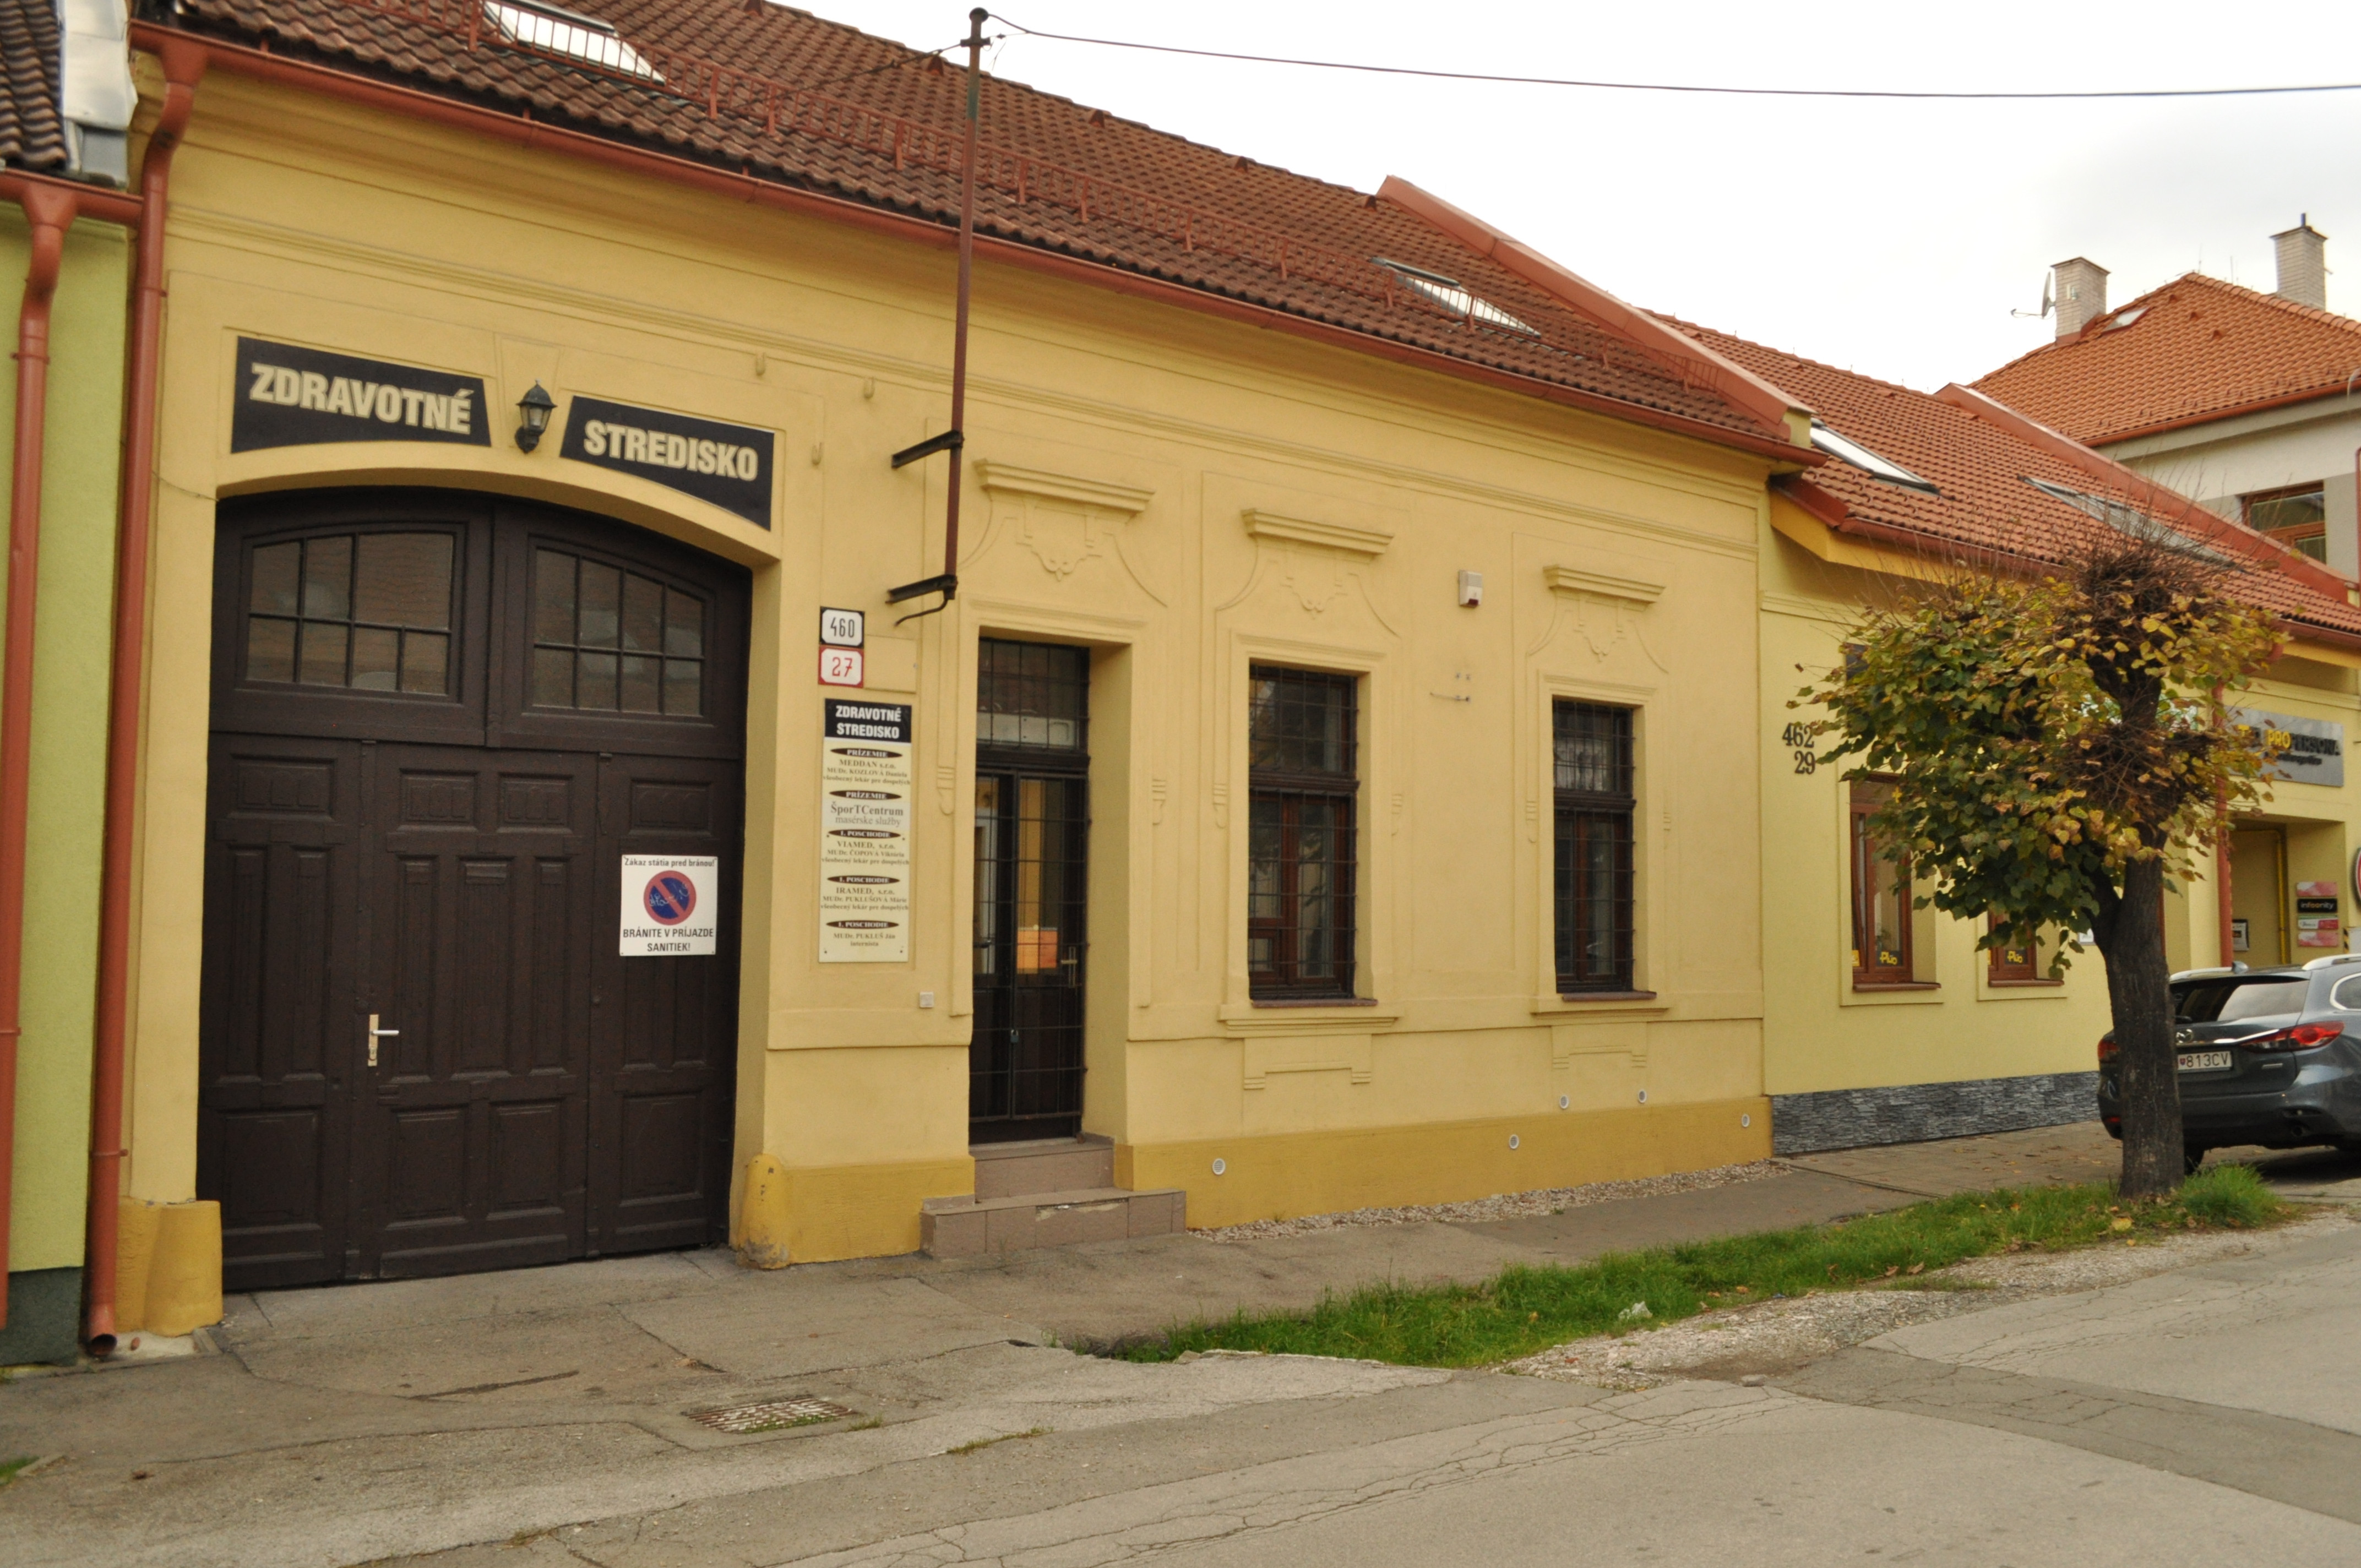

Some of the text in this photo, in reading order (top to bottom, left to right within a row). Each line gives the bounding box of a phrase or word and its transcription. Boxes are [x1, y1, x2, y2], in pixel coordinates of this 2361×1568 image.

[249, 363, 474, 434] ZDRAVOTNÉ
[584, 420, 759, 482] STREDISKO
[830, 617, 855, 638] 460
[832, 657, 853, 677] 27
[835, 705, 901, 722] ZDRAVOTNÉ
[836, 723, 900, 739] STREDISKO
[1782, 722, 1814, 748] 462
[846, 749, 888, 758] PRÍZEMIE
[839, 759, 878, 767] MEDDAN
[1794, 750, 1815, 775] 29
[846, 791, 888, 799] PRÍZEMIE
[835, 815, 901, 827] masérske služby
[624, 858, 646, 866] Zákaz
[648, 858, 669, 866] státia
[671, 859, 687, 868] pred
[623, 926, 714, 938] BRÁNITE V PRÍJAZDE
[647, 943, 691, 952] SANITIEK!
[2186, 1053, 2228, 1068] 813CV
